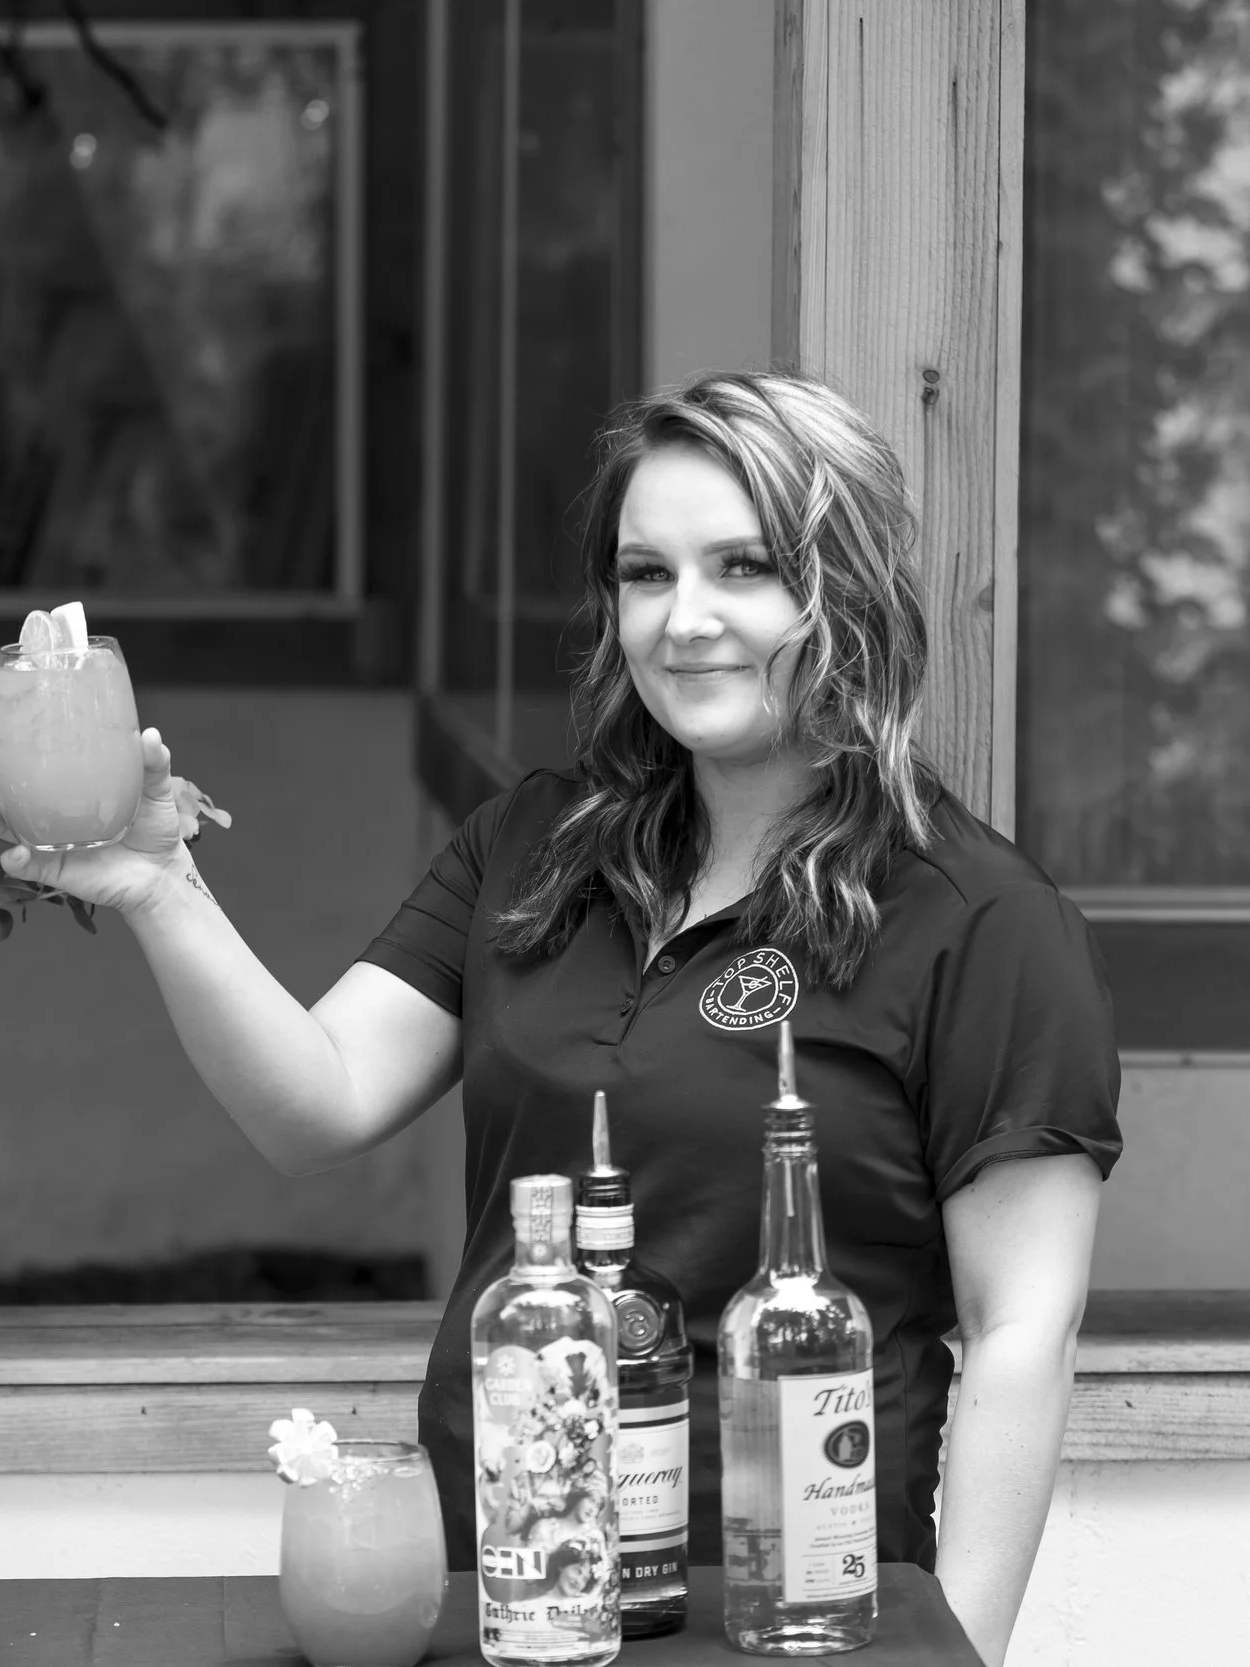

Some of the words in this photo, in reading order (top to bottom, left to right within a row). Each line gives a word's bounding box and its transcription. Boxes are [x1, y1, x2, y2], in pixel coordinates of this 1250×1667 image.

[712, 958, 746, 988] TOP
[753, 952, 794, 1006] SHELF
[705, 997, 774, 1026] BARTENDING
[621, 1495, 659, 1507] ORTED
[635, 1565, 659, 1579] DRY
[662, 1562, 678, 1575] GIN
[842, 1554, 865, 1578] 25
